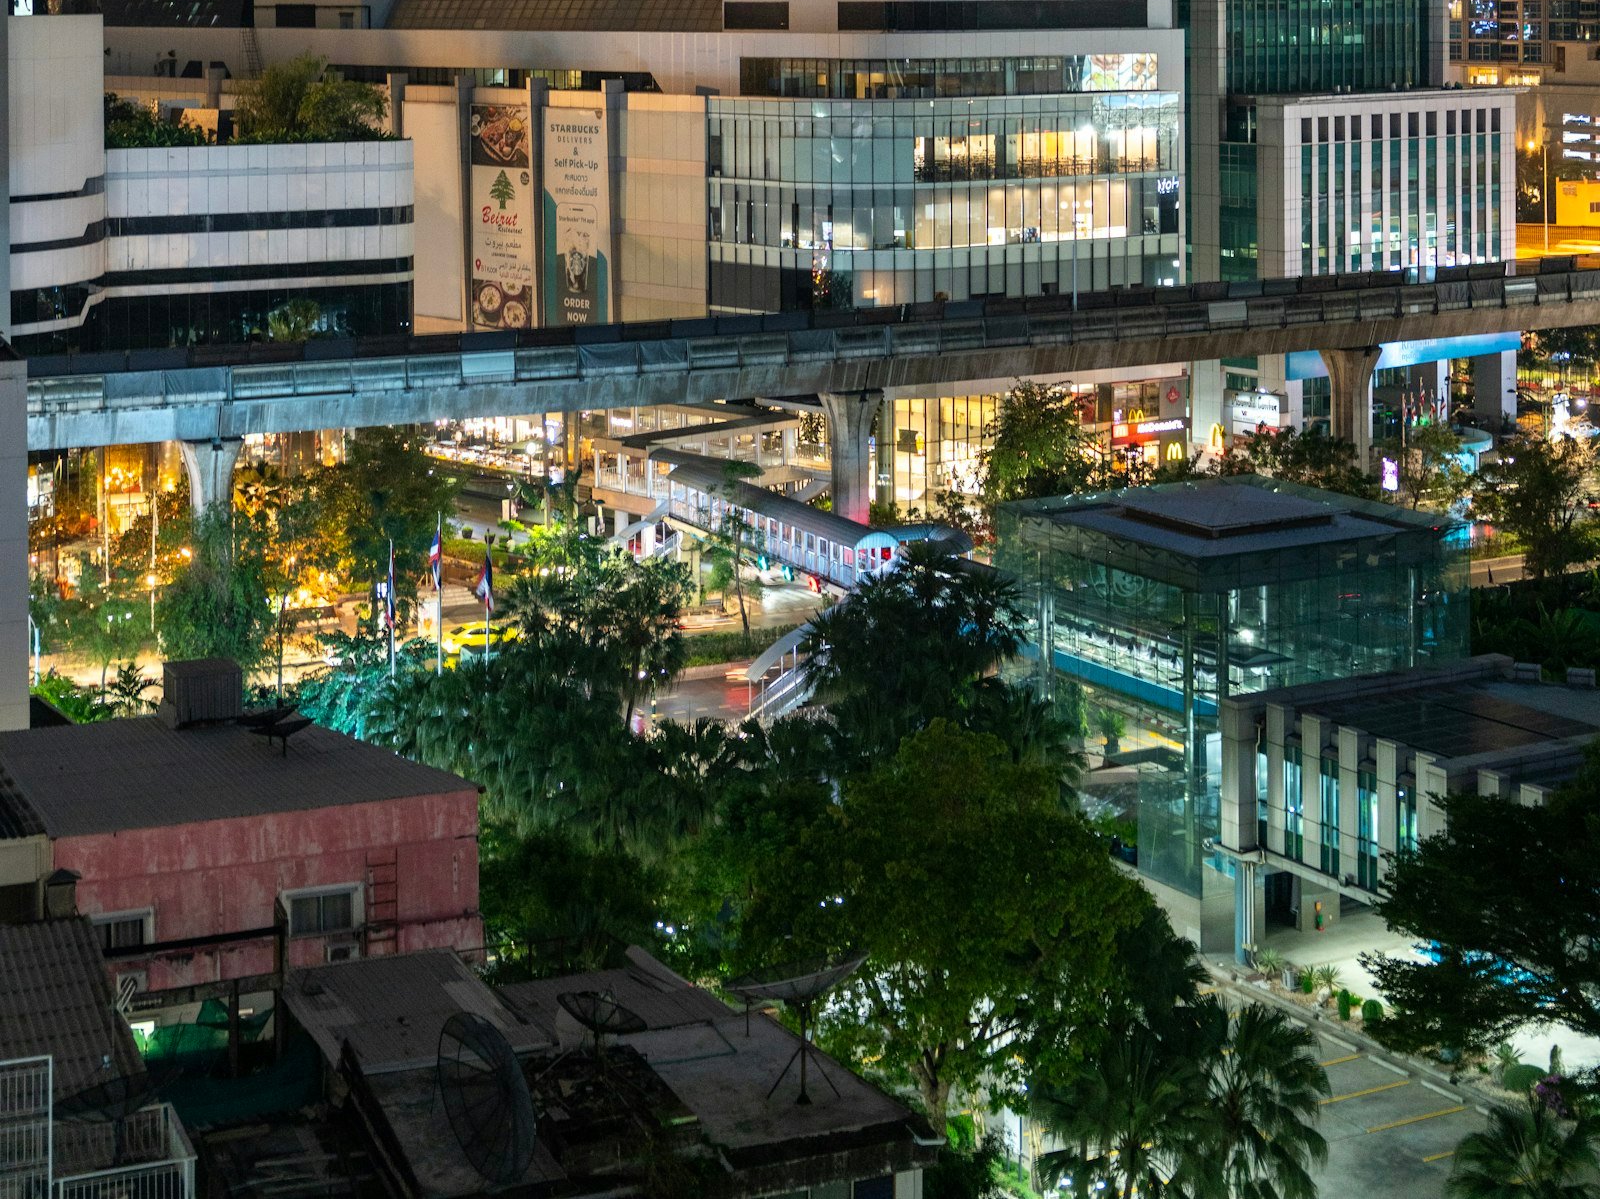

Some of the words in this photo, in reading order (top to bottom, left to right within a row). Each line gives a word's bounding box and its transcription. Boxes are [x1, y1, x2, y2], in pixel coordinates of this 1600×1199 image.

[550, 123, 600, 134] STARBUCKS
[557, 135, 593, 144] DELIVERS
[572, 146, 579, 156] &
[554, 158, 568, 168] Self
[568, 159, 599, 171] Pick-Up
[481, 205, 518, 226] Beirut
[563, 296, 590, 309] ORDER
[566, 311, 588, 323] NOW
